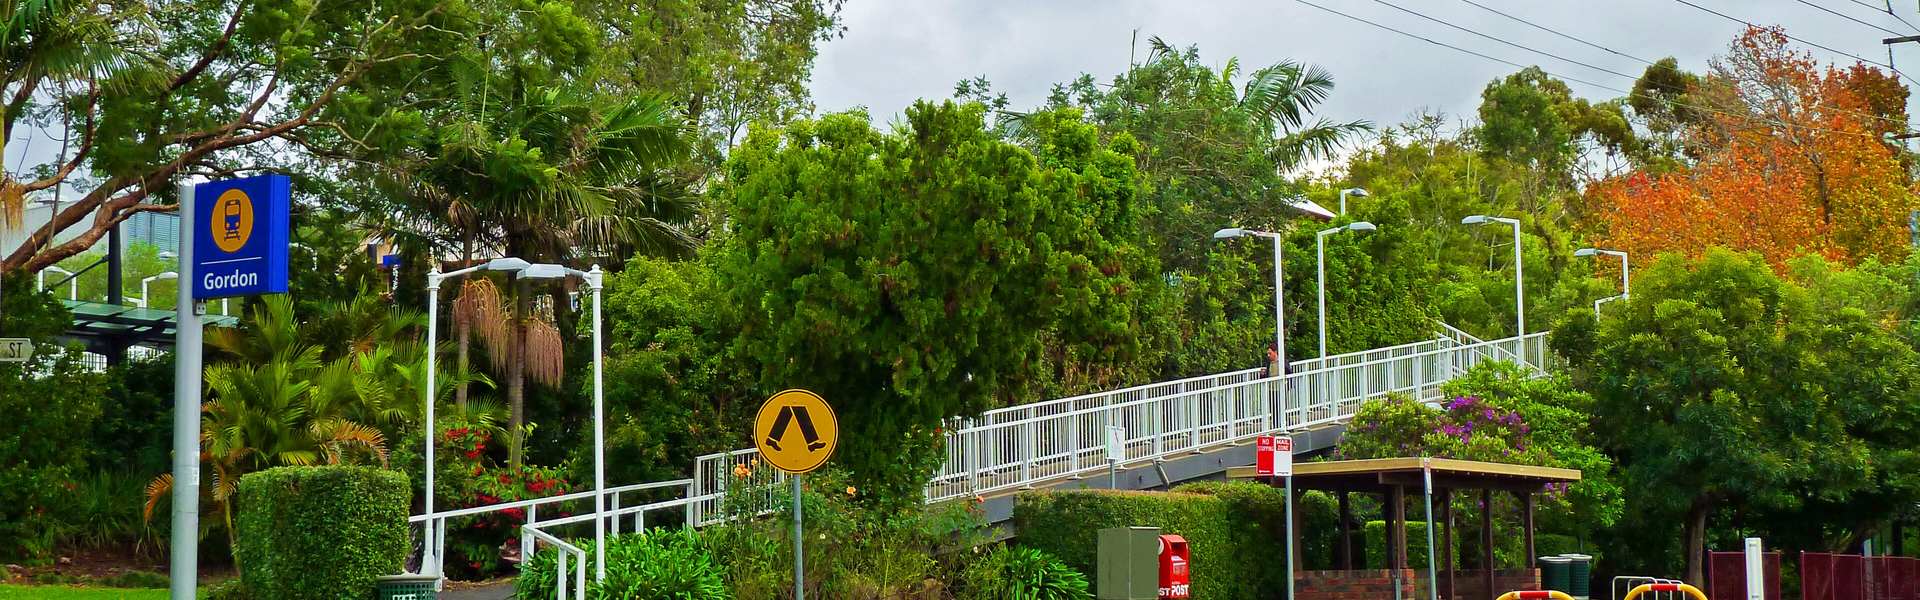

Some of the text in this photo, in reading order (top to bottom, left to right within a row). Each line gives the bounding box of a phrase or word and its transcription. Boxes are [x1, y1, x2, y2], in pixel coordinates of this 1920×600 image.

[204, 269, 258, 290] Gordon
[9, 342, 23, 358] ST
[1171, 584, 1189, 597] POST
